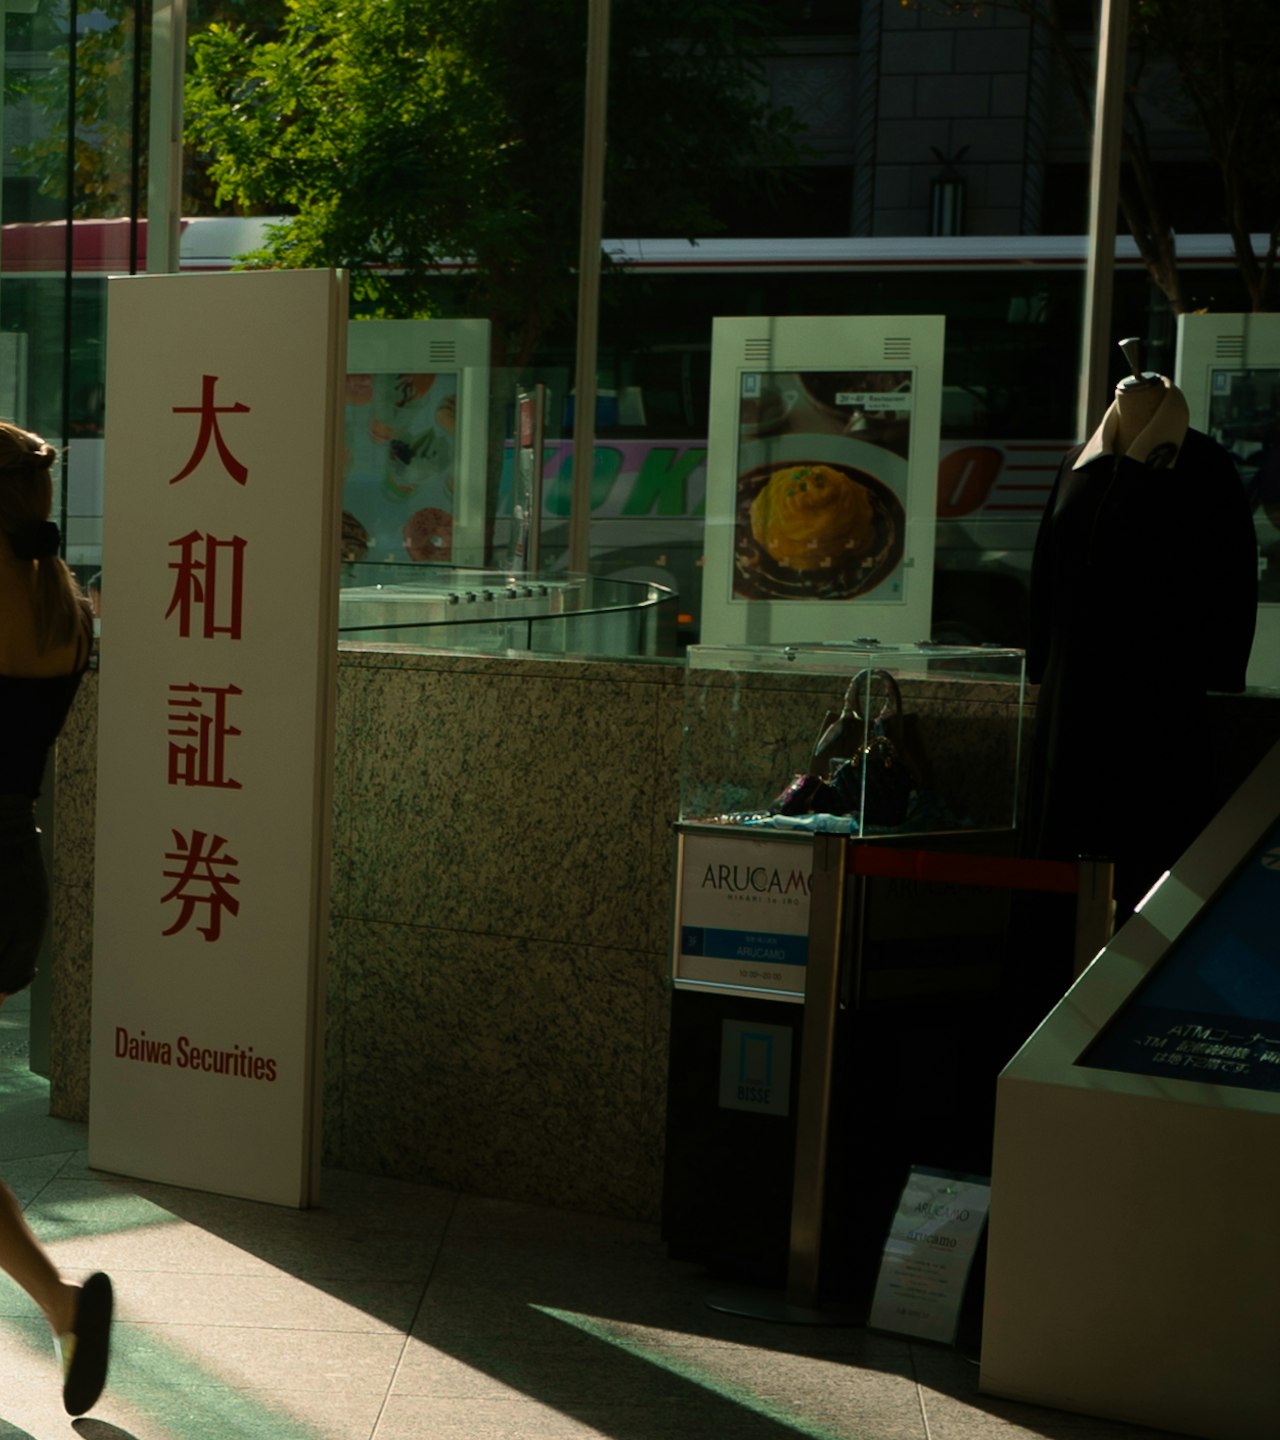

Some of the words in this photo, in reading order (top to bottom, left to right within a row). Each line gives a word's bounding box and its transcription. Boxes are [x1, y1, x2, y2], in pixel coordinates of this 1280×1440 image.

[160, 374, 251, 943] 大和証券
[702, 864, 813, 896] ARUCAM
[737, 946, 786, 961] ARUCAMO
[115, 1026, 172, 1066] Daiwa
[176, 1036, 277, 1082] Securities
[737, 1085, 771, 1104] BISSE
